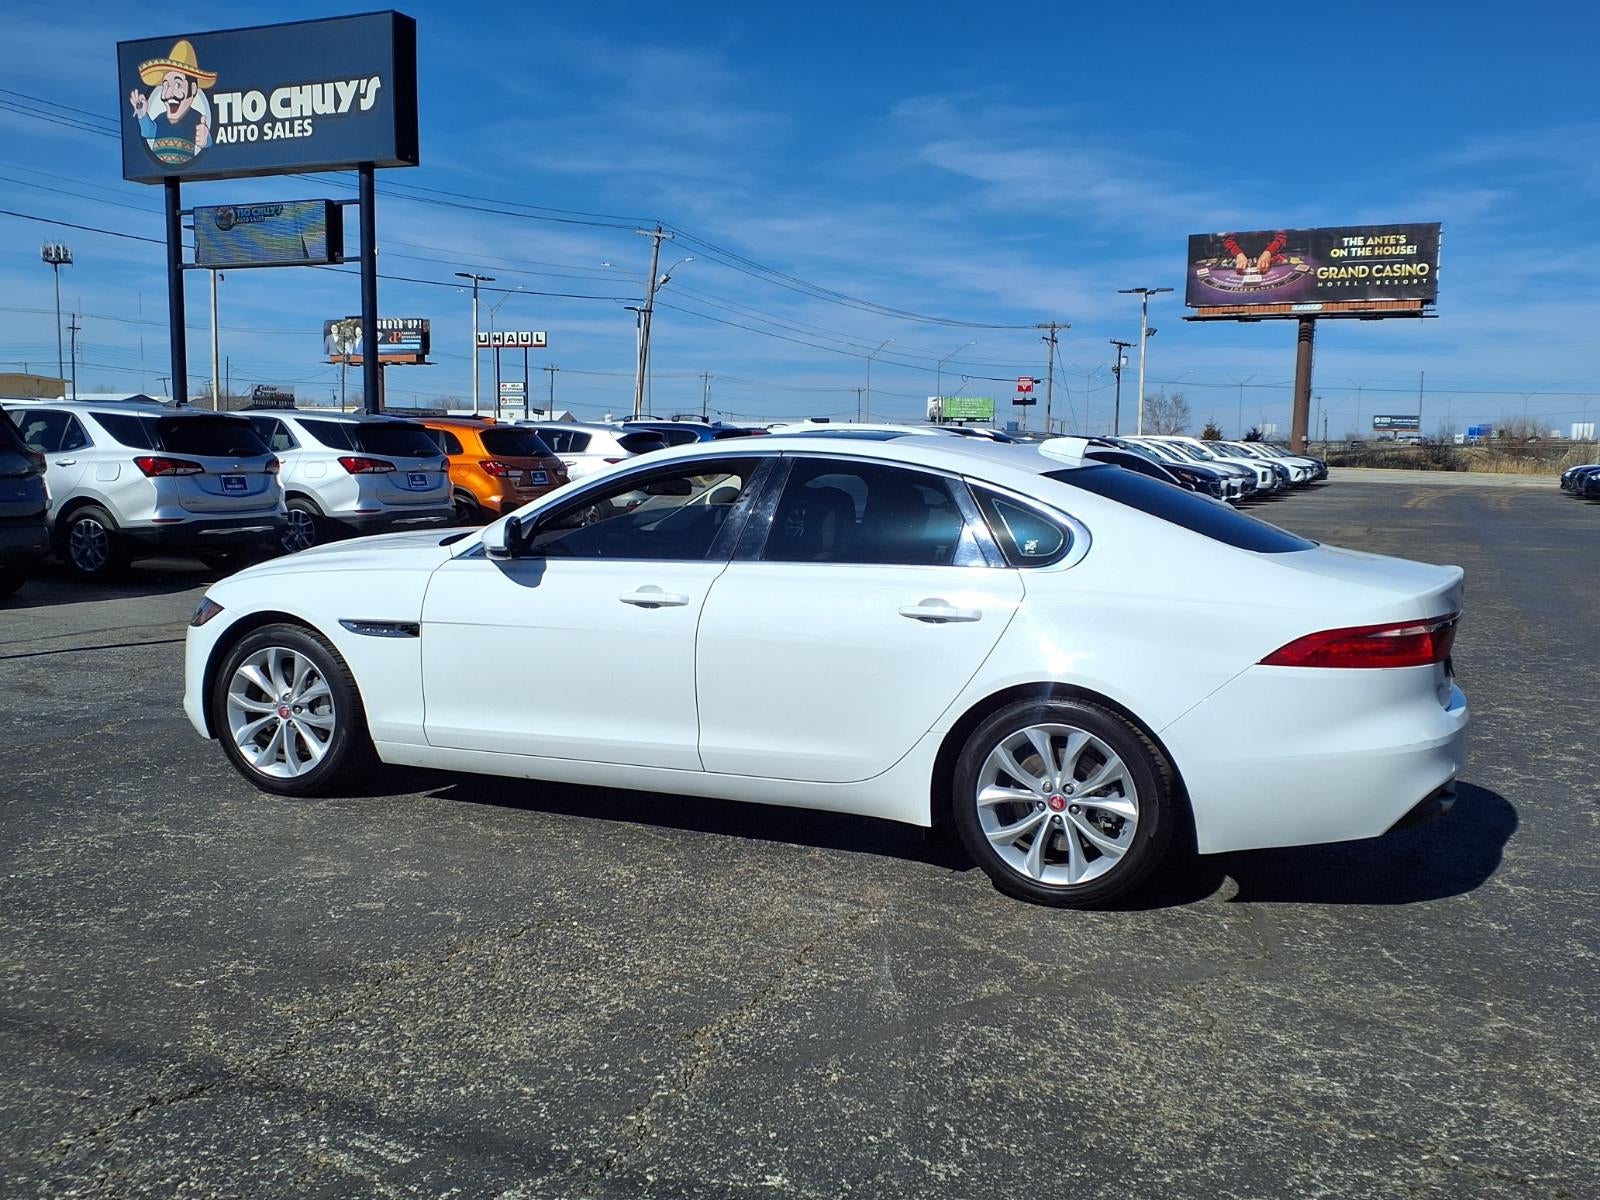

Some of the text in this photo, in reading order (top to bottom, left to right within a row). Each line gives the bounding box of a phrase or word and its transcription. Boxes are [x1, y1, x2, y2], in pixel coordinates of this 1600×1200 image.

[213, 76, 381, 124] TIO CHUY'S
[215, 119, 313, 144] AUTO SALES
[1342, 234, 1407, 247] THE ANTE'S
[1330, 245, 1418, 258] ON THE HOUSE!
[1316, 263, 1430, 279] GRAND CASINO
[1375, 278, 1429, 286] RESORT
[376, 319, 423, 330] UNDER UP!
